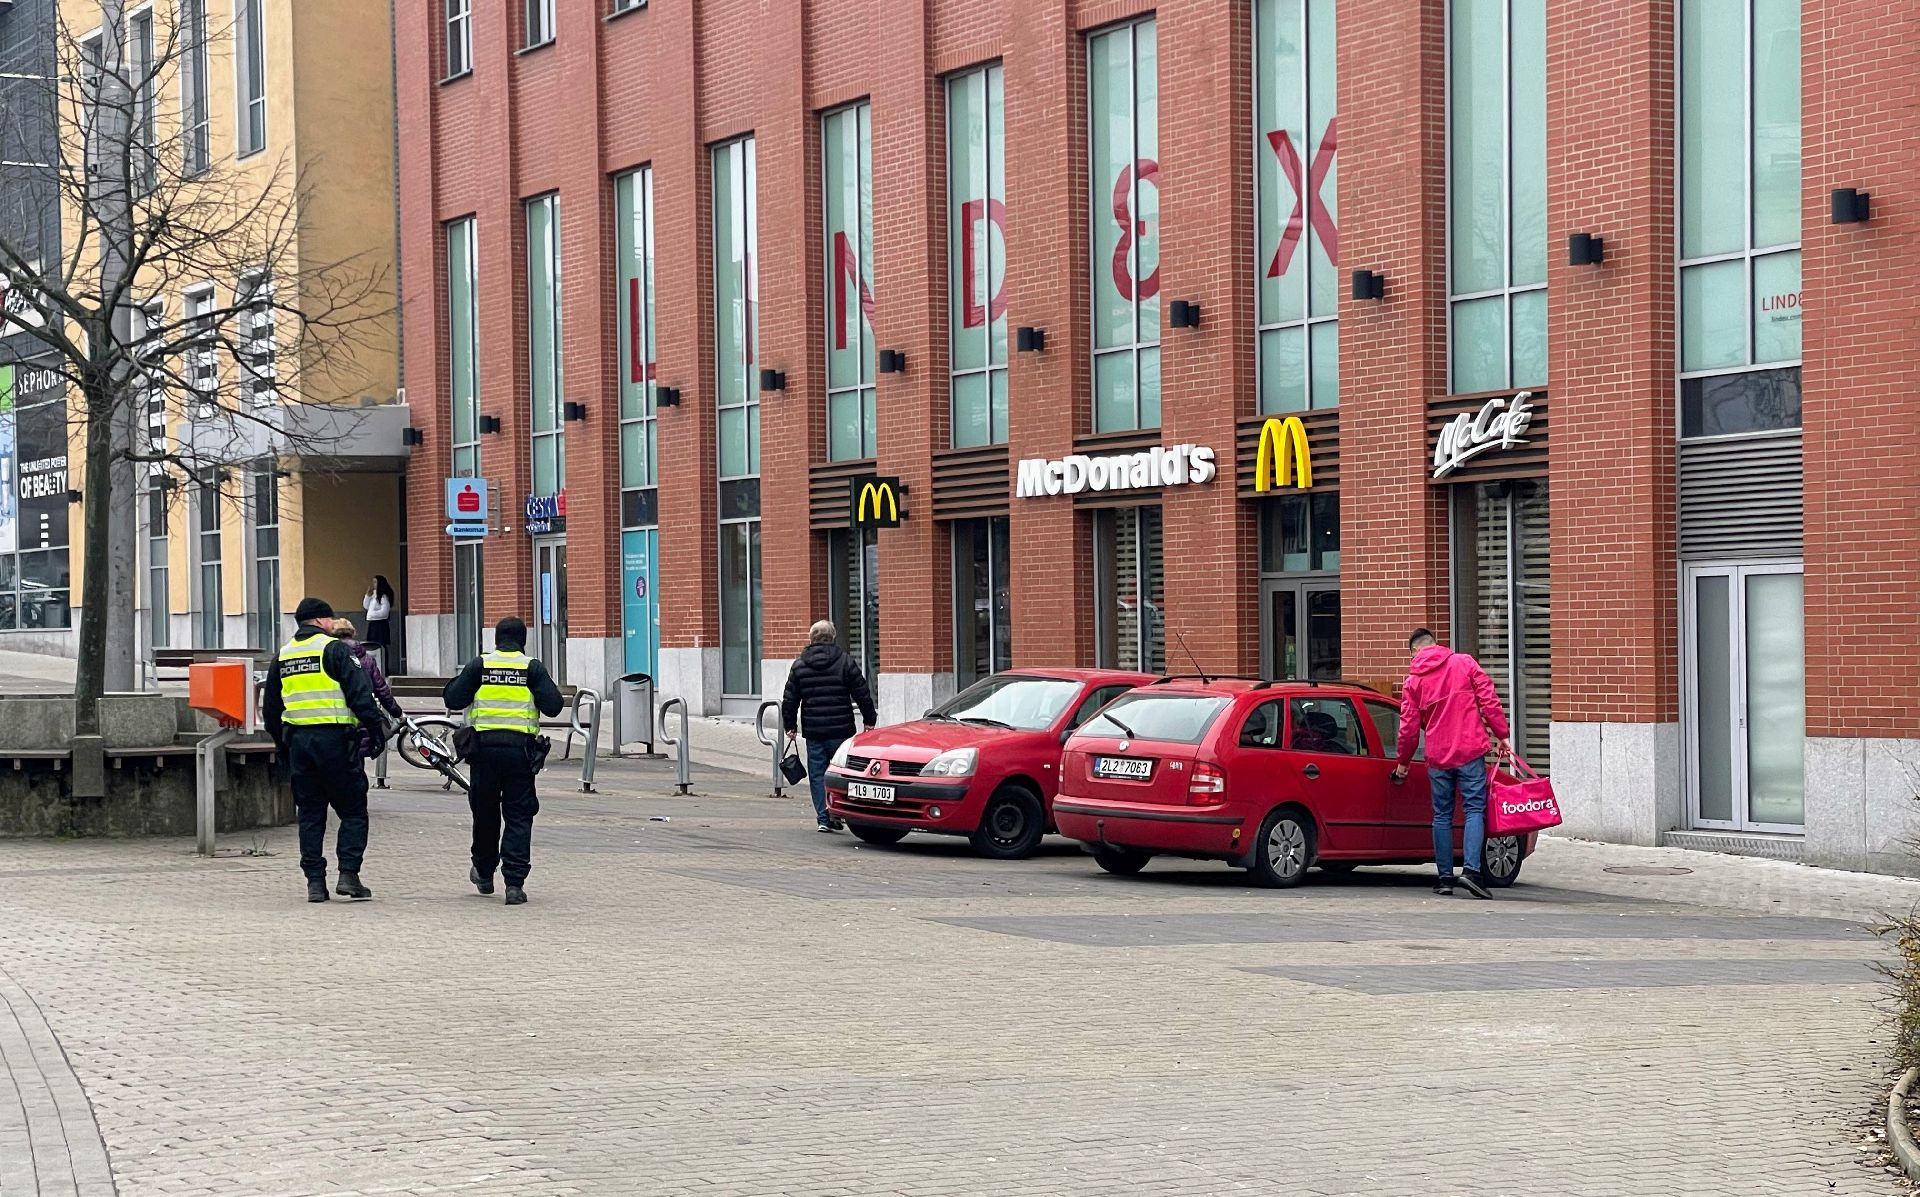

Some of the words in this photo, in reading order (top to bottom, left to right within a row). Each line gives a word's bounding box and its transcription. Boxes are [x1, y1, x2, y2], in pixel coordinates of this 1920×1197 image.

[1433, 391, 1534, 479] McCafé
[1016, 443, 1216, 498] McDonald's
[20, 476, 32, 499] OF
[279, 662, 320, 677] POLICIE
[481, 675, 528, 685] POLICIE
[1502, 798, 1554, 815] foodora
